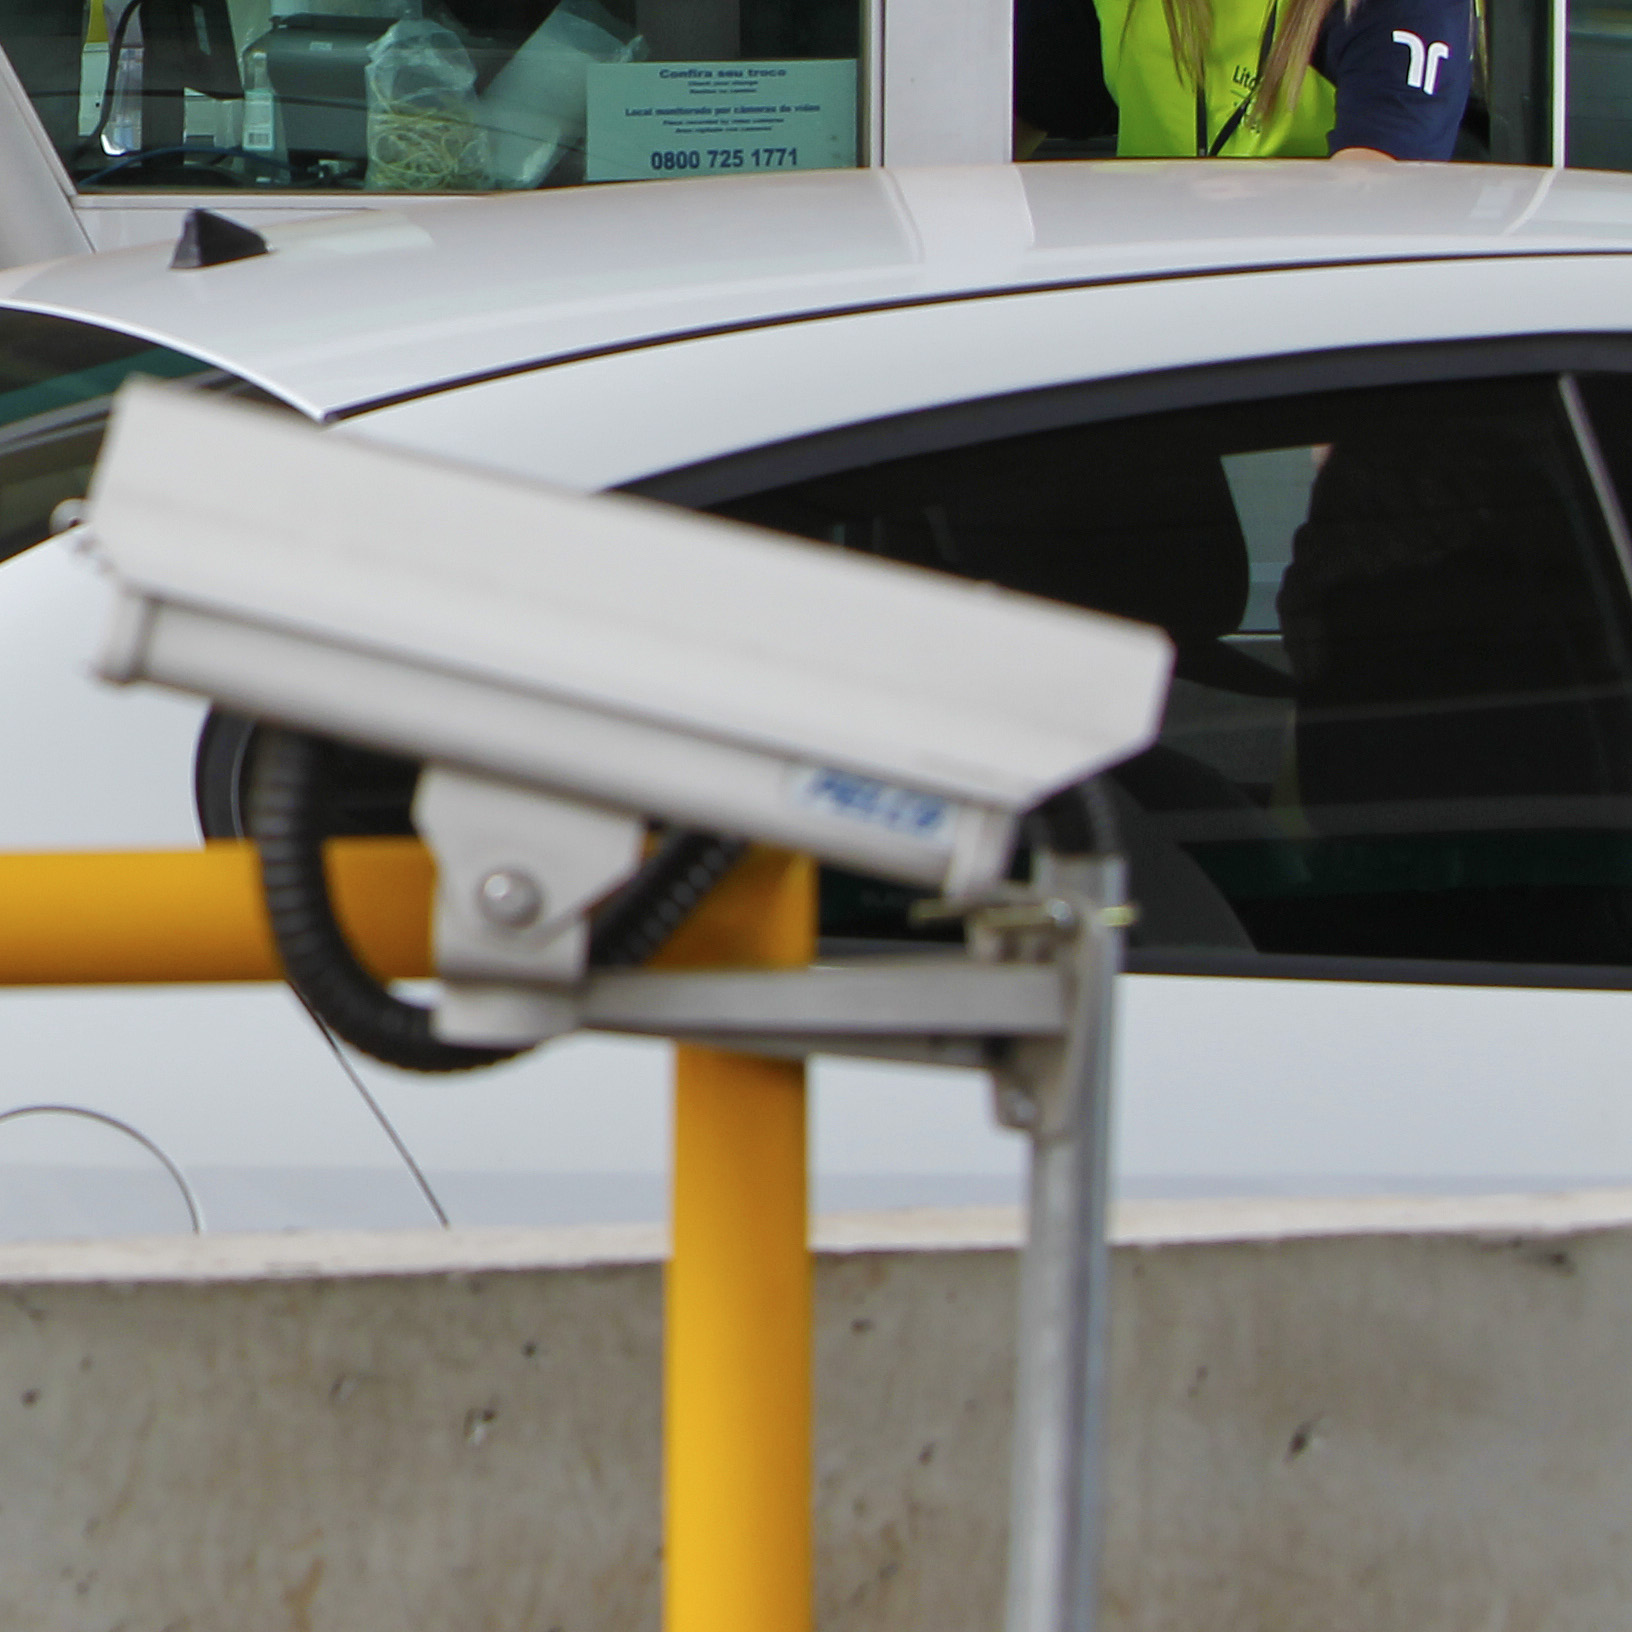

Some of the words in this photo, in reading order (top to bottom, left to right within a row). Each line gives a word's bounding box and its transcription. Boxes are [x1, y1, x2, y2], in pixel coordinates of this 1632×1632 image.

[651, 150, 701, 170] 0800
[707, 149, 744, 168] 725
[751, 147, 798, 167] 1771
